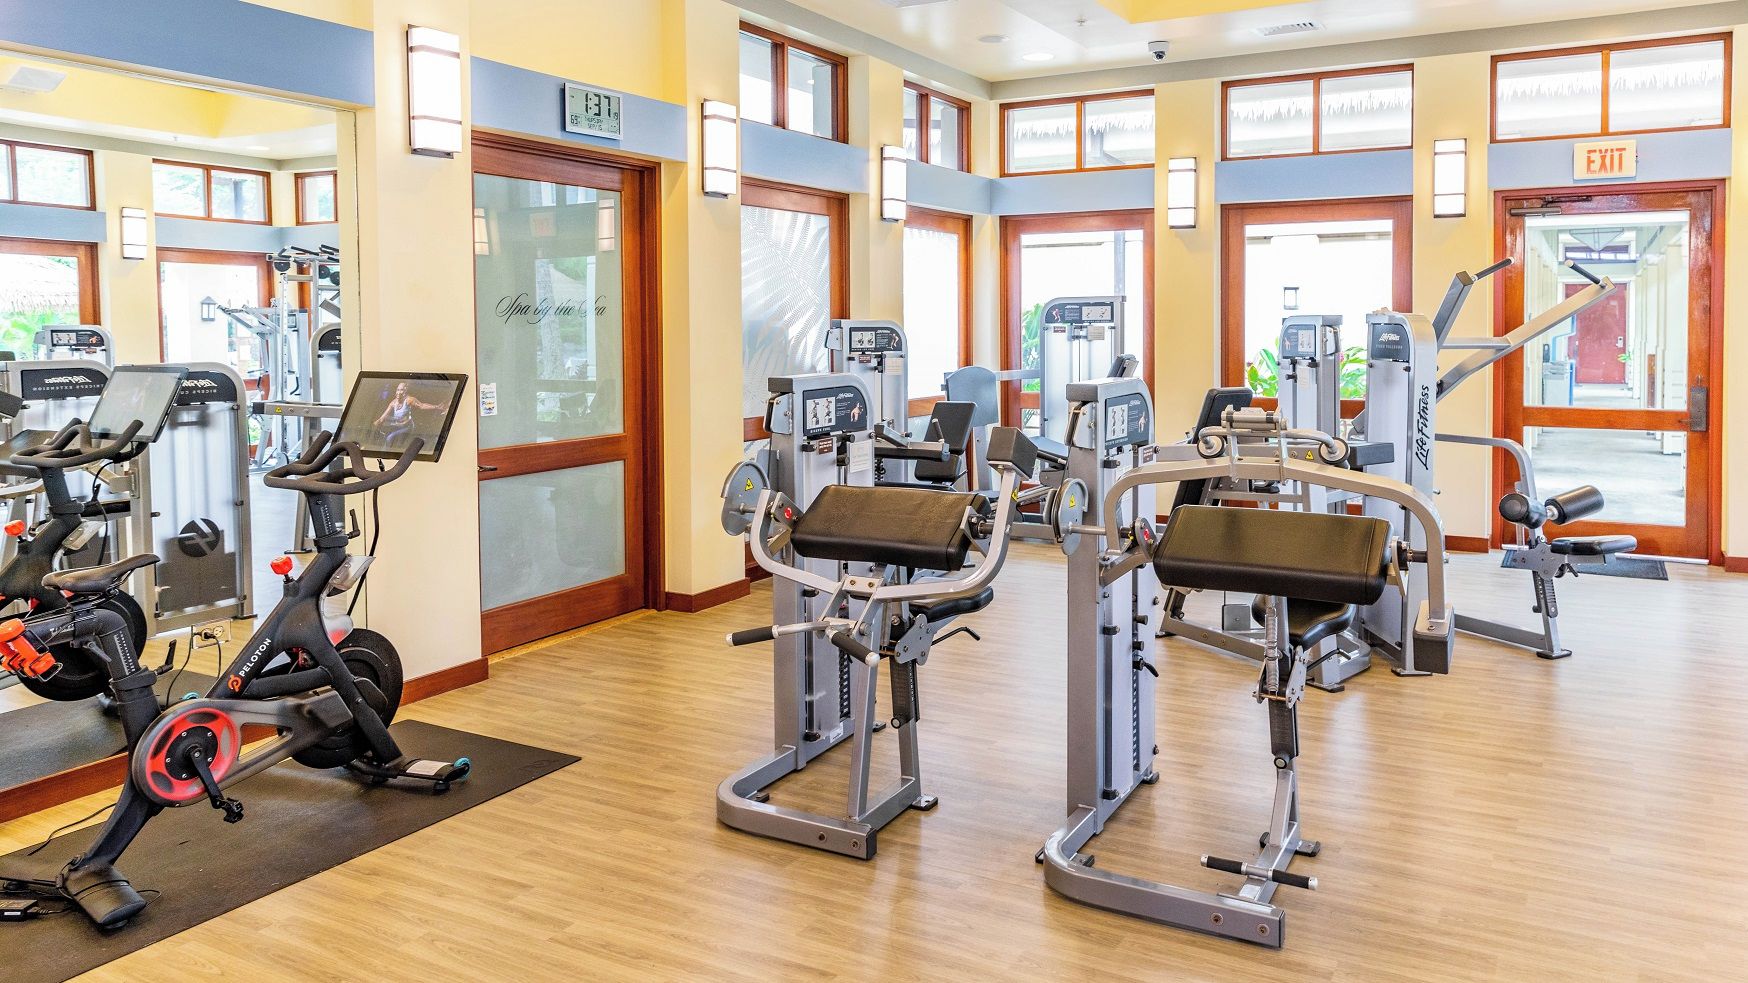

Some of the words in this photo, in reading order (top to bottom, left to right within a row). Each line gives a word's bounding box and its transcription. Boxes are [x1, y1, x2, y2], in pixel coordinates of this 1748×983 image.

[585, 93, 611, 118] 1:37
[1586, 147, 1627, 175] EXIT
[495, 293, 531, 325] Spa
[527, 298, 552, 325] by
[554, 299, 575, 316] the
[238, 638, 272, 677] PELOTON
